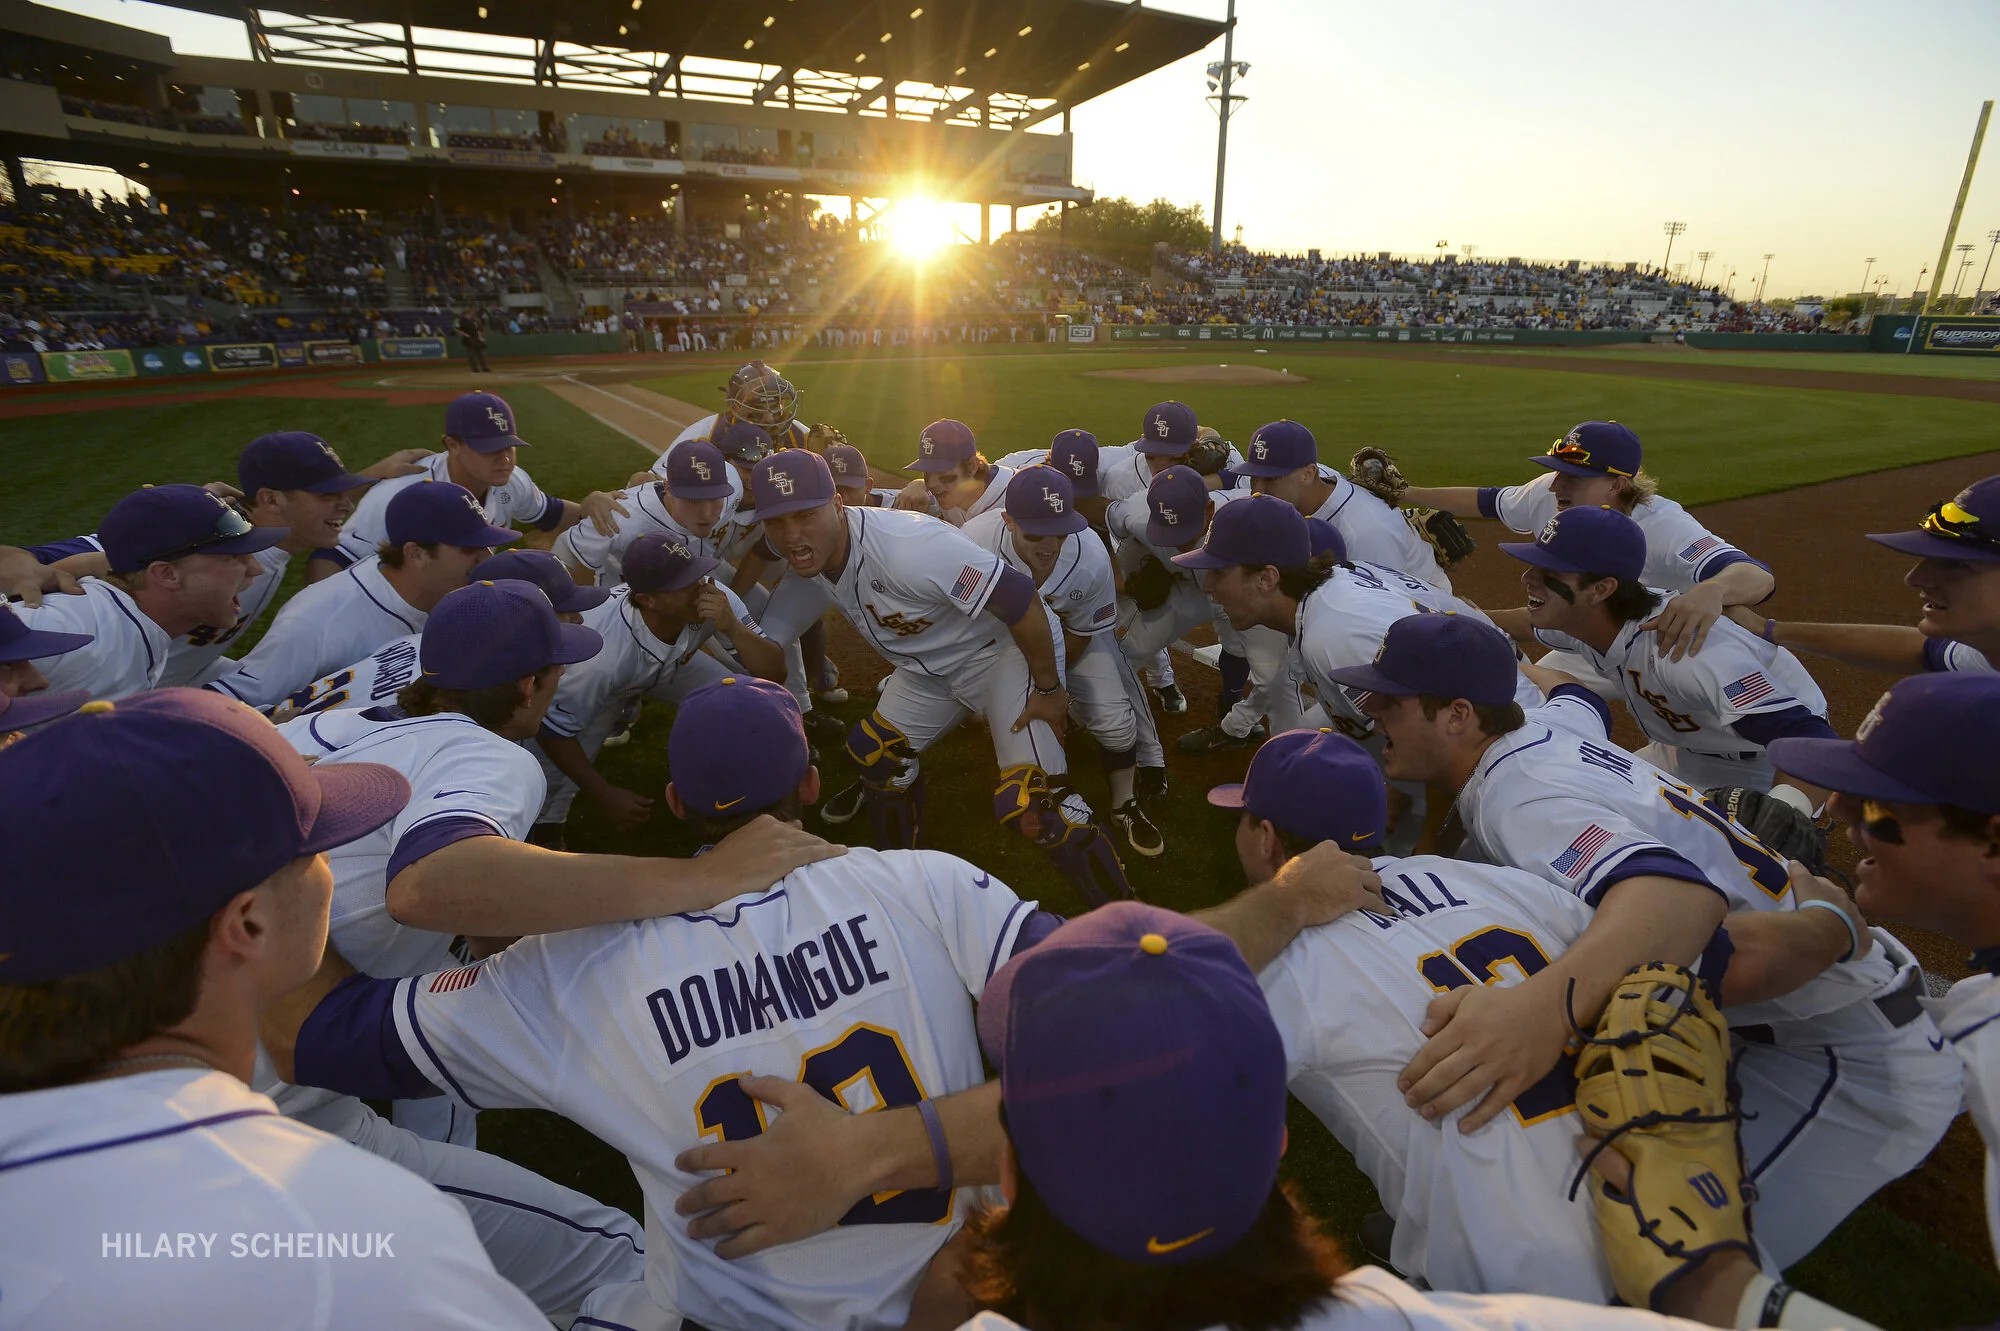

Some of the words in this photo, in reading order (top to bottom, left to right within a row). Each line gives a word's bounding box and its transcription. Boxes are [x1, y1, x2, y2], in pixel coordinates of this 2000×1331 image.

[1933, 330, 2000, 339] SUPERIOR
[486, 407, 508, 432] LSU
[1154, 414, 1170, 438] LSU
[921, 432, 934, 455] LSU
[1254, 434, 1269, 460] LSU
[690, 456, 711, 481] LSU
[832, 453, 847, 473] LSU
[1069, 454, 1085, 476] LSU
[767, 465, 795, 496] LSU
[1042, 487, 1065, 513] LSU
[1158, 502, 1178, 525] LSU
[864, 602, 934, 636] LSU
[1626, 669, 1701, 733] LSU
[645, 913, 890, 1065] DOMANGUE
[1689, 1171, 1729, 1211] W
